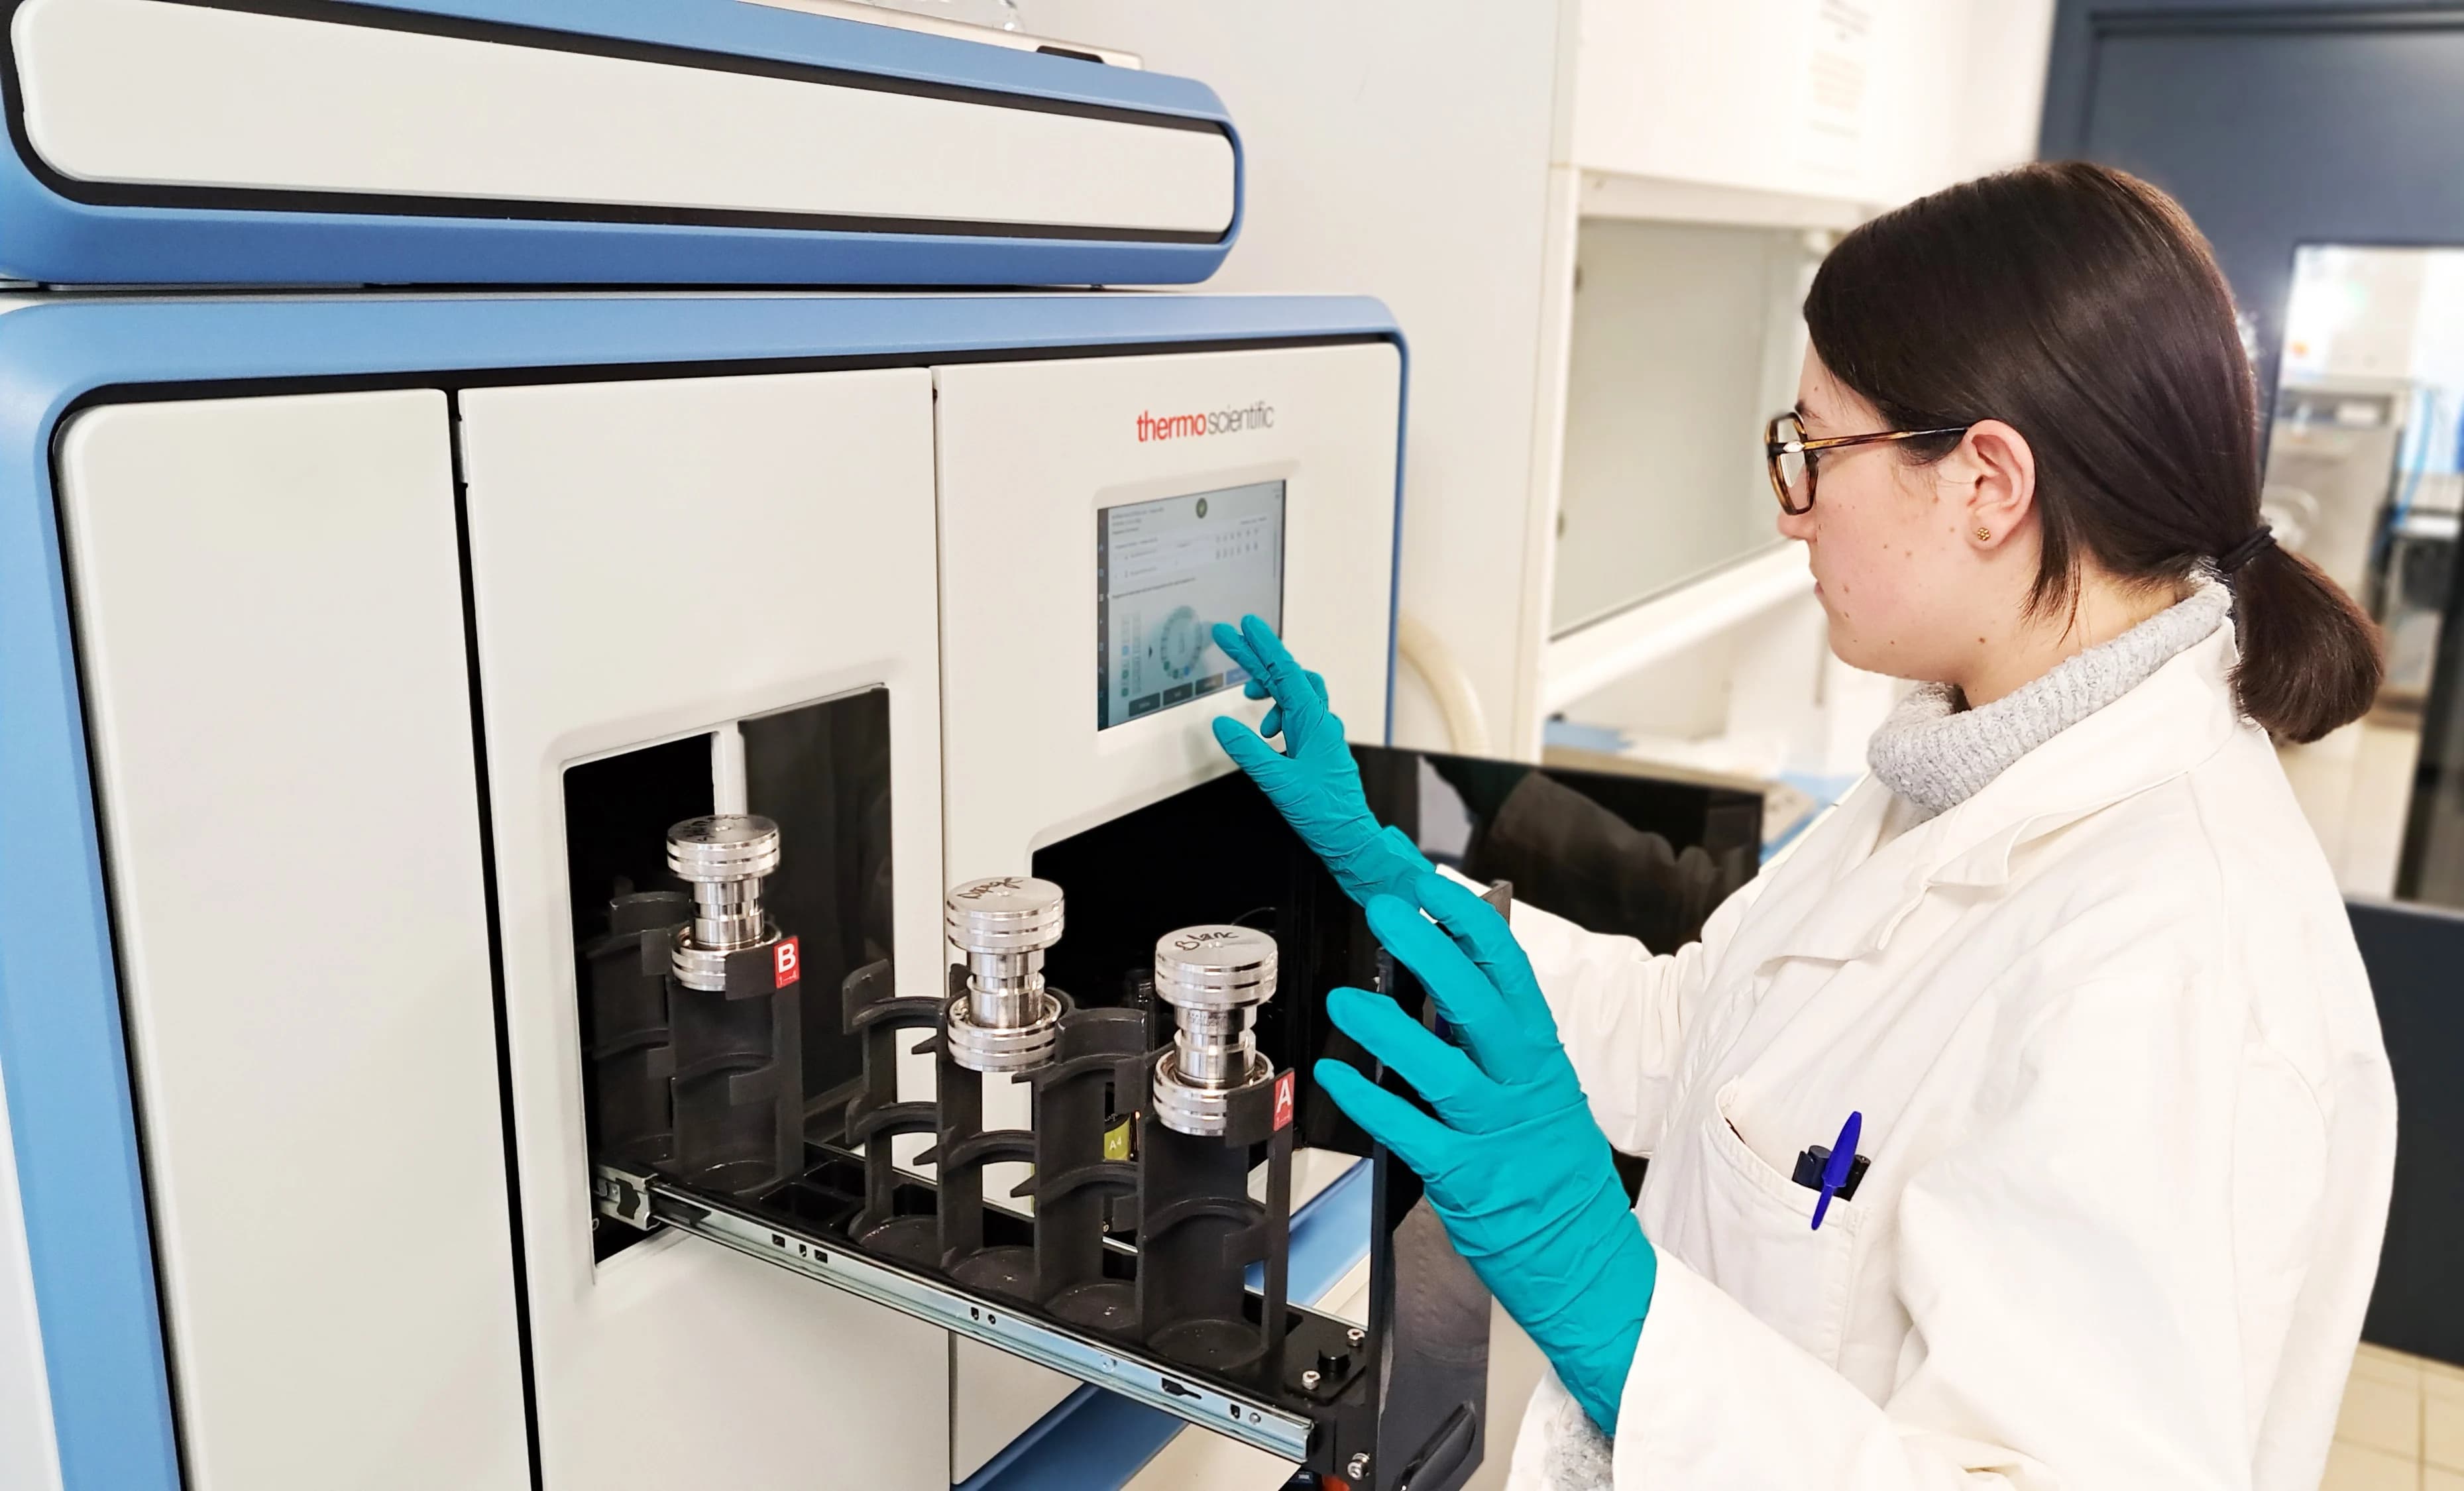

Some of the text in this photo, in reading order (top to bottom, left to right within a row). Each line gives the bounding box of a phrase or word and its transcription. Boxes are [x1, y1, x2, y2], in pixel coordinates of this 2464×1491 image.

[1137, 400, 1274, 442] thermo scientific
[1175, 932, 1239, 951] Blanc
[778, 943, 796, 973] B
[1276, 1078, 1292, 1114] A
[1109, 1136, 1122, 1151] A4
